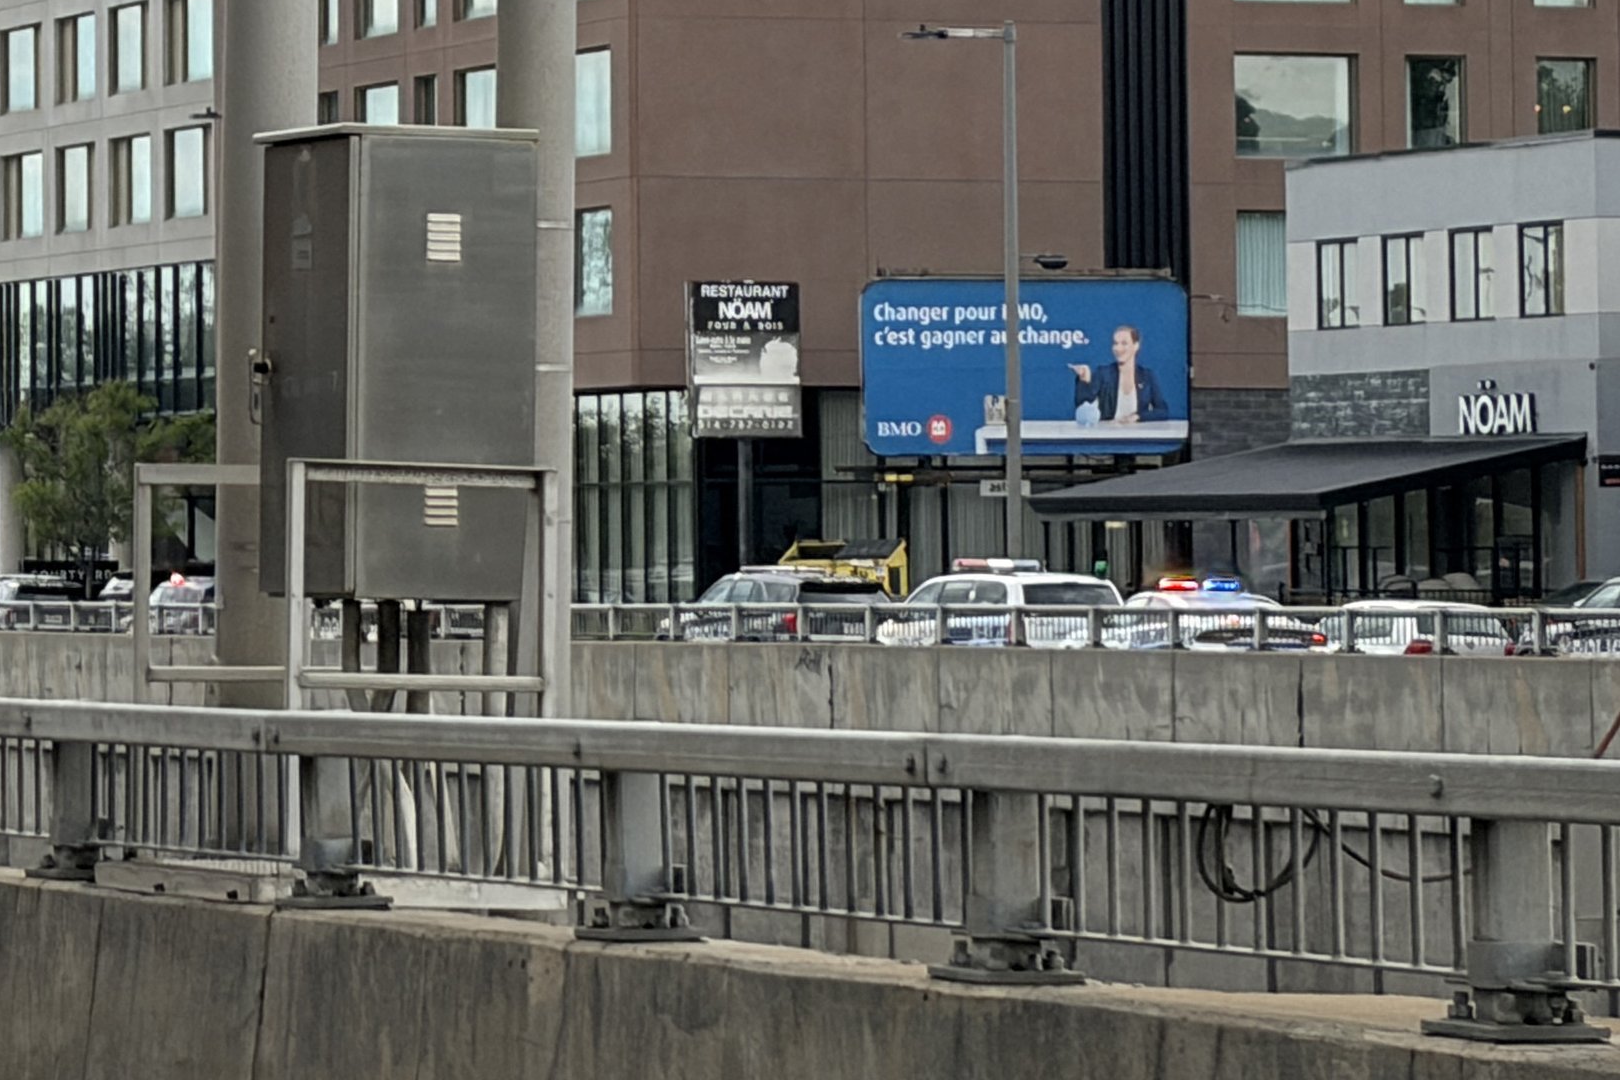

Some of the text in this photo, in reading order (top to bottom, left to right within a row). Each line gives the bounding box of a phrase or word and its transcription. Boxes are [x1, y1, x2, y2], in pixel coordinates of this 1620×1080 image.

[700, 284, 790, 298] RESTAURANT
[718, 298, 773, 320] NÖAM
[873, 302, 1048, 324] Changer pour MO,
[920, 330, 984, 349] gagner
[1017, 325, 1089, 349] change.
[1458, 379, 1532, 435] NÖAM
[878, 422, 921, 437] BMO
[989, 482, 1006, 493] ast
[31, 569, 113, 581] COURTYRD
